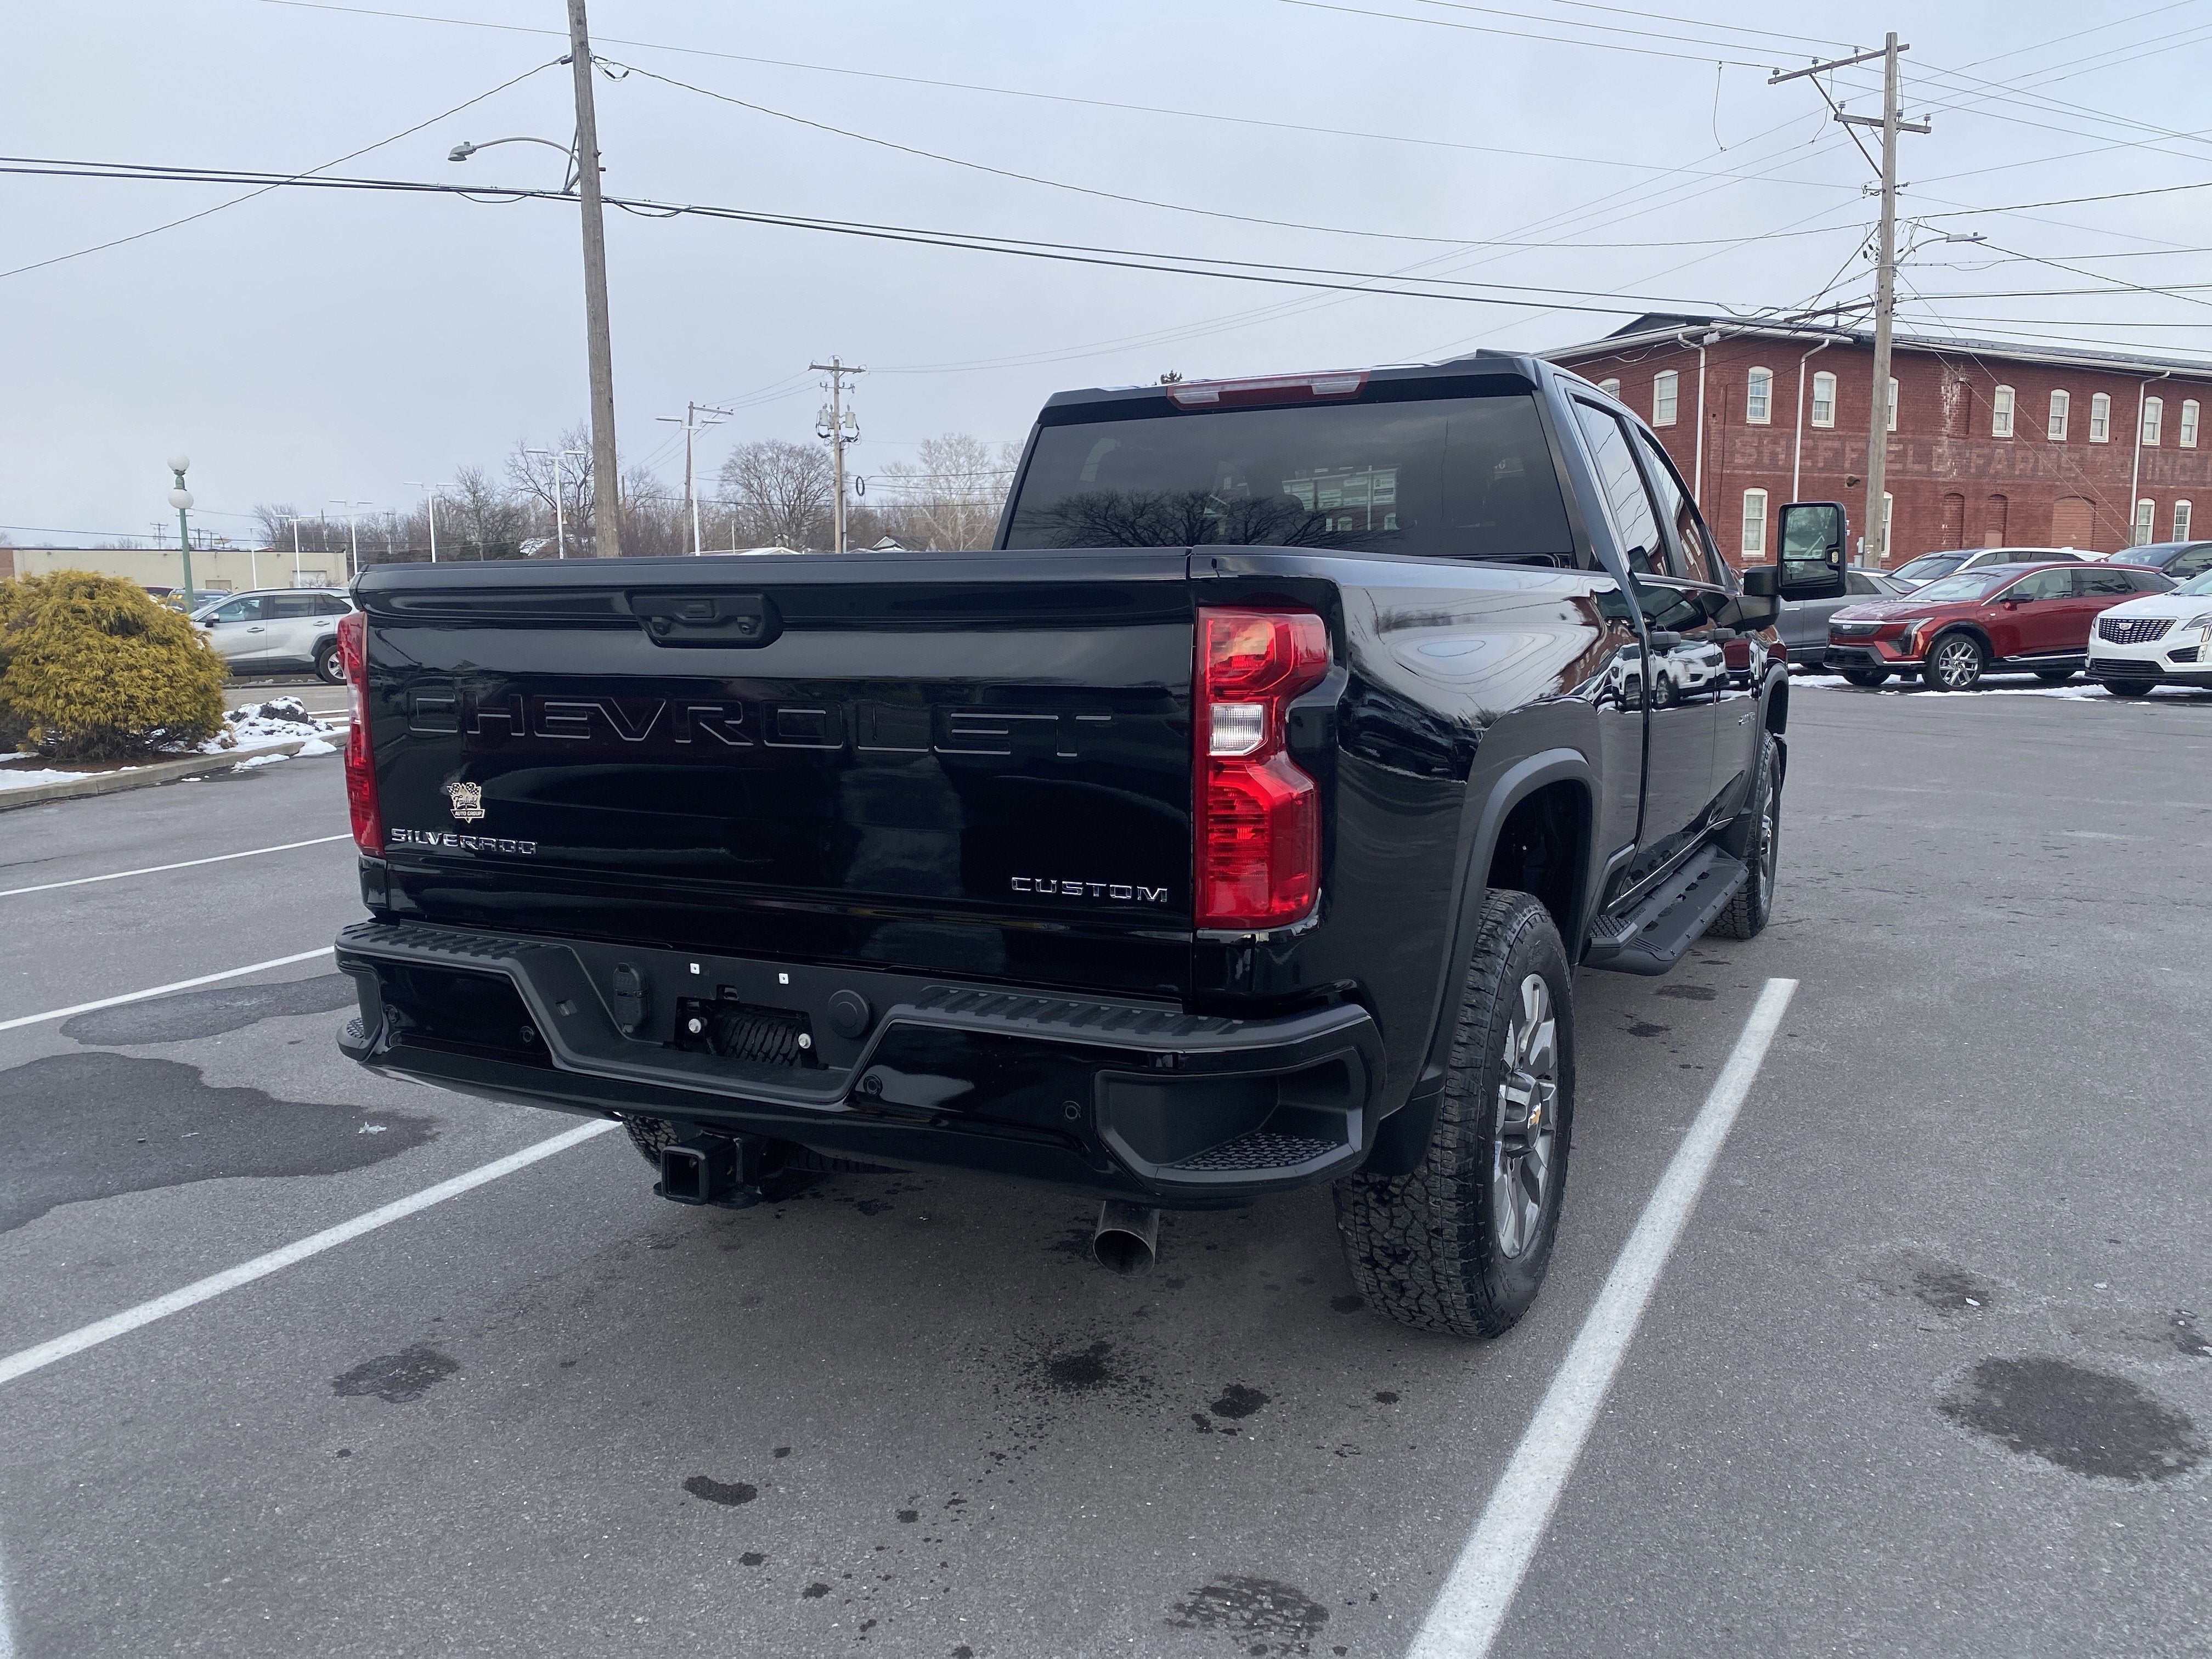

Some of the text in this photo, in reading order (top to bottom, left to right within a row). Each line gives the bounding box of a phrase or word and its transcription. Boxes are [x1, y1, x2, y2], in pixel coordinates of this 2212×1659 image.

[1733, 437, 1951, 472] SHEFFELD
[407, 689, 1113, 757] CHEVROLET
[391, 828, 538, 855] SILVERADO
[1012, 877, 1168, 902] CUSTOM
